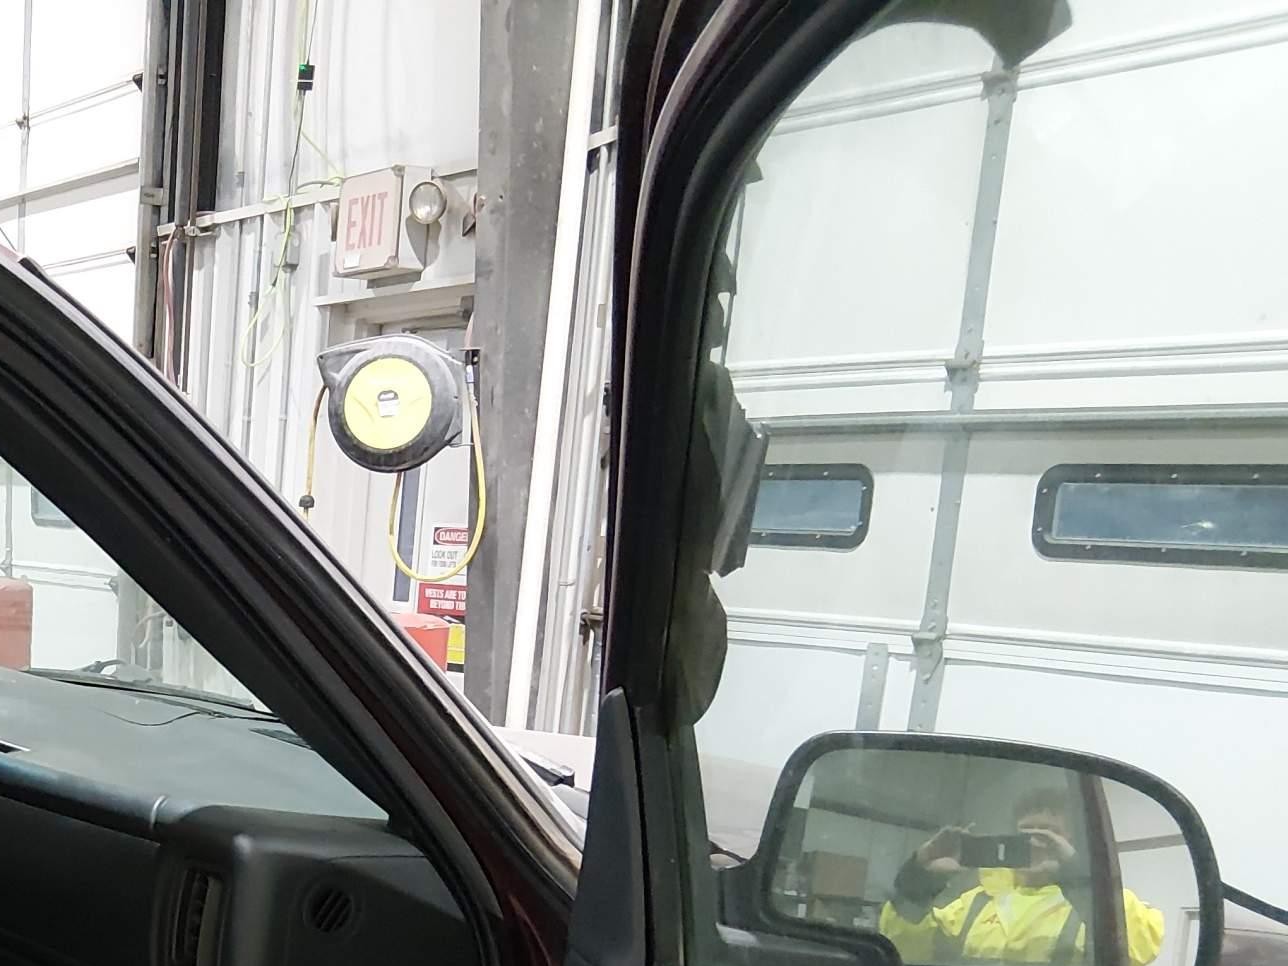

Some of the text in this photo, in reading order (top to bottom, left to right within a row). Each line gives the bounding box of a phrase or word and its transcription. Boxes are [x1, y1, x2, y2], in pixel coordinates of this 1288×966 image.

[345, 192, 388, 251] EXIT
[439, 531, 468, 543] DANGE
[444, 589, 456, 600] ARE
